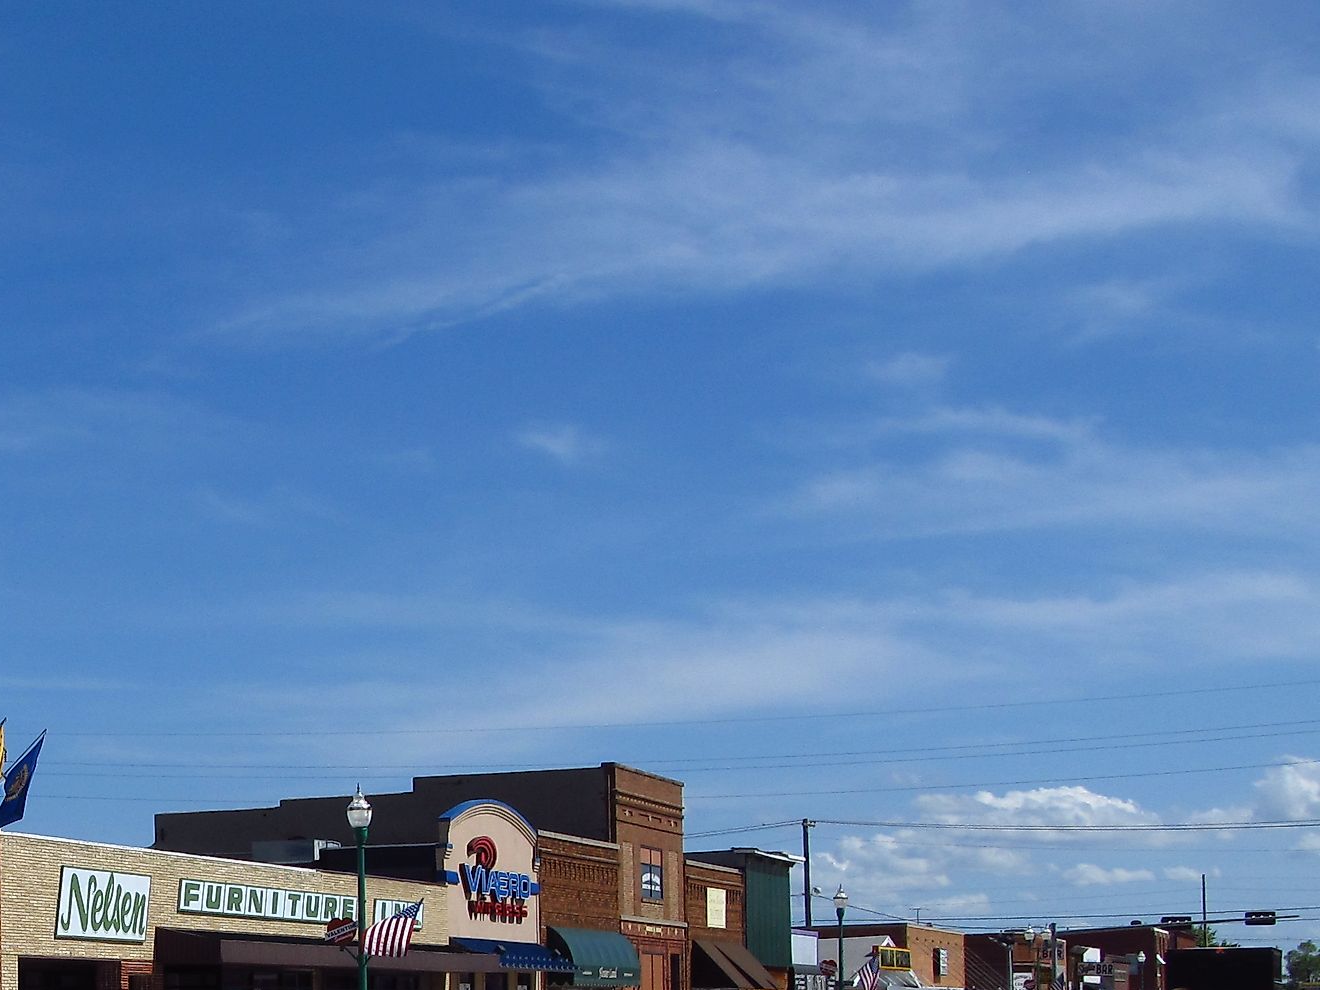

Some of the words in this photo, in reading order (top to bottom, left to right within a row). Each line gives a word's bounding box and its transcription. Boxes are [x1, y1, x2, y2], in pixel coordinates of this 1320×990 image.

[184, 882, 354, 919] FURNITURE
[464, 863, 531, 903] VIAERO
[61, 872, 146, 935] Nelsen
[1096, 964, 1113, 975] BAR
